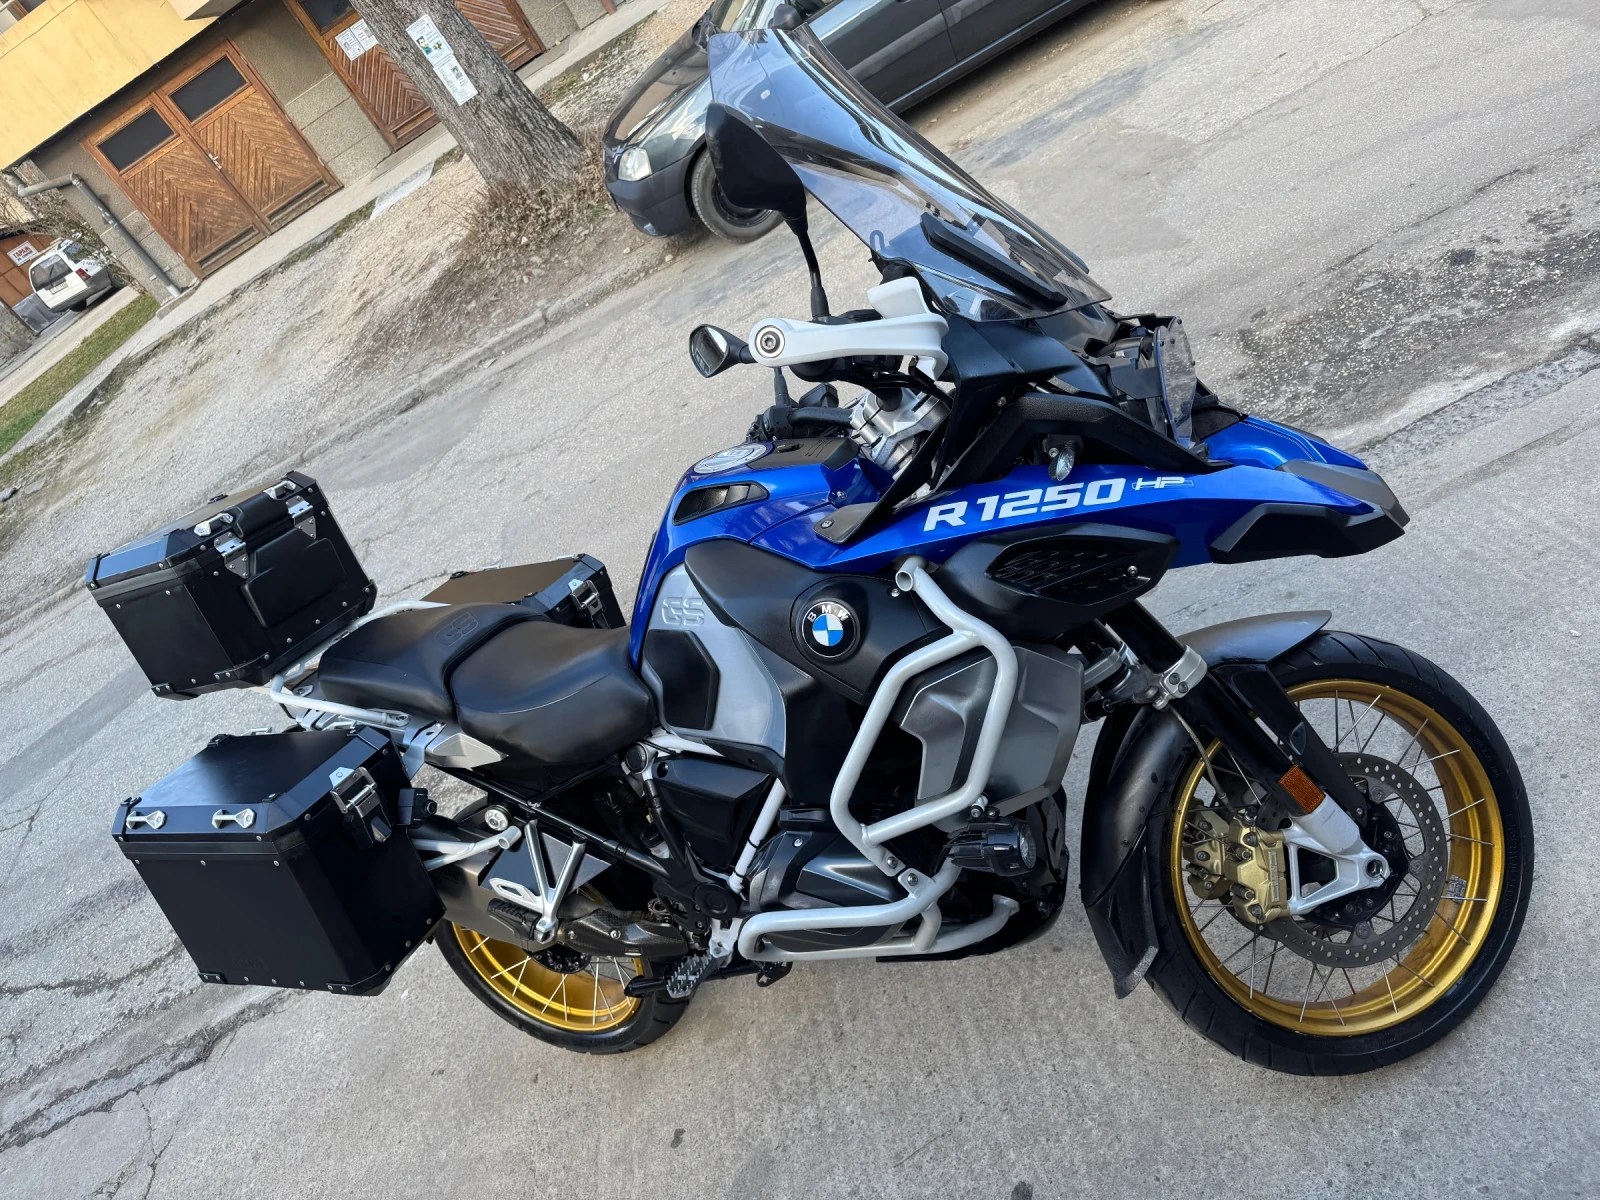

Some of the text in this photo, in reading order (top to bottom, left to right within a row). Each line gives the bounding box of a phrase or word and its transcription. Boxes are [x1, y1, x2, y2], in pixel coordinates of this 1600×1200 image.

[923, 476, 1186, 532] R 1250 HP
[661, 596, 706, 626] GS
[807, 604, 849, 623] BMW
[434, 611, 479, 646] GS
